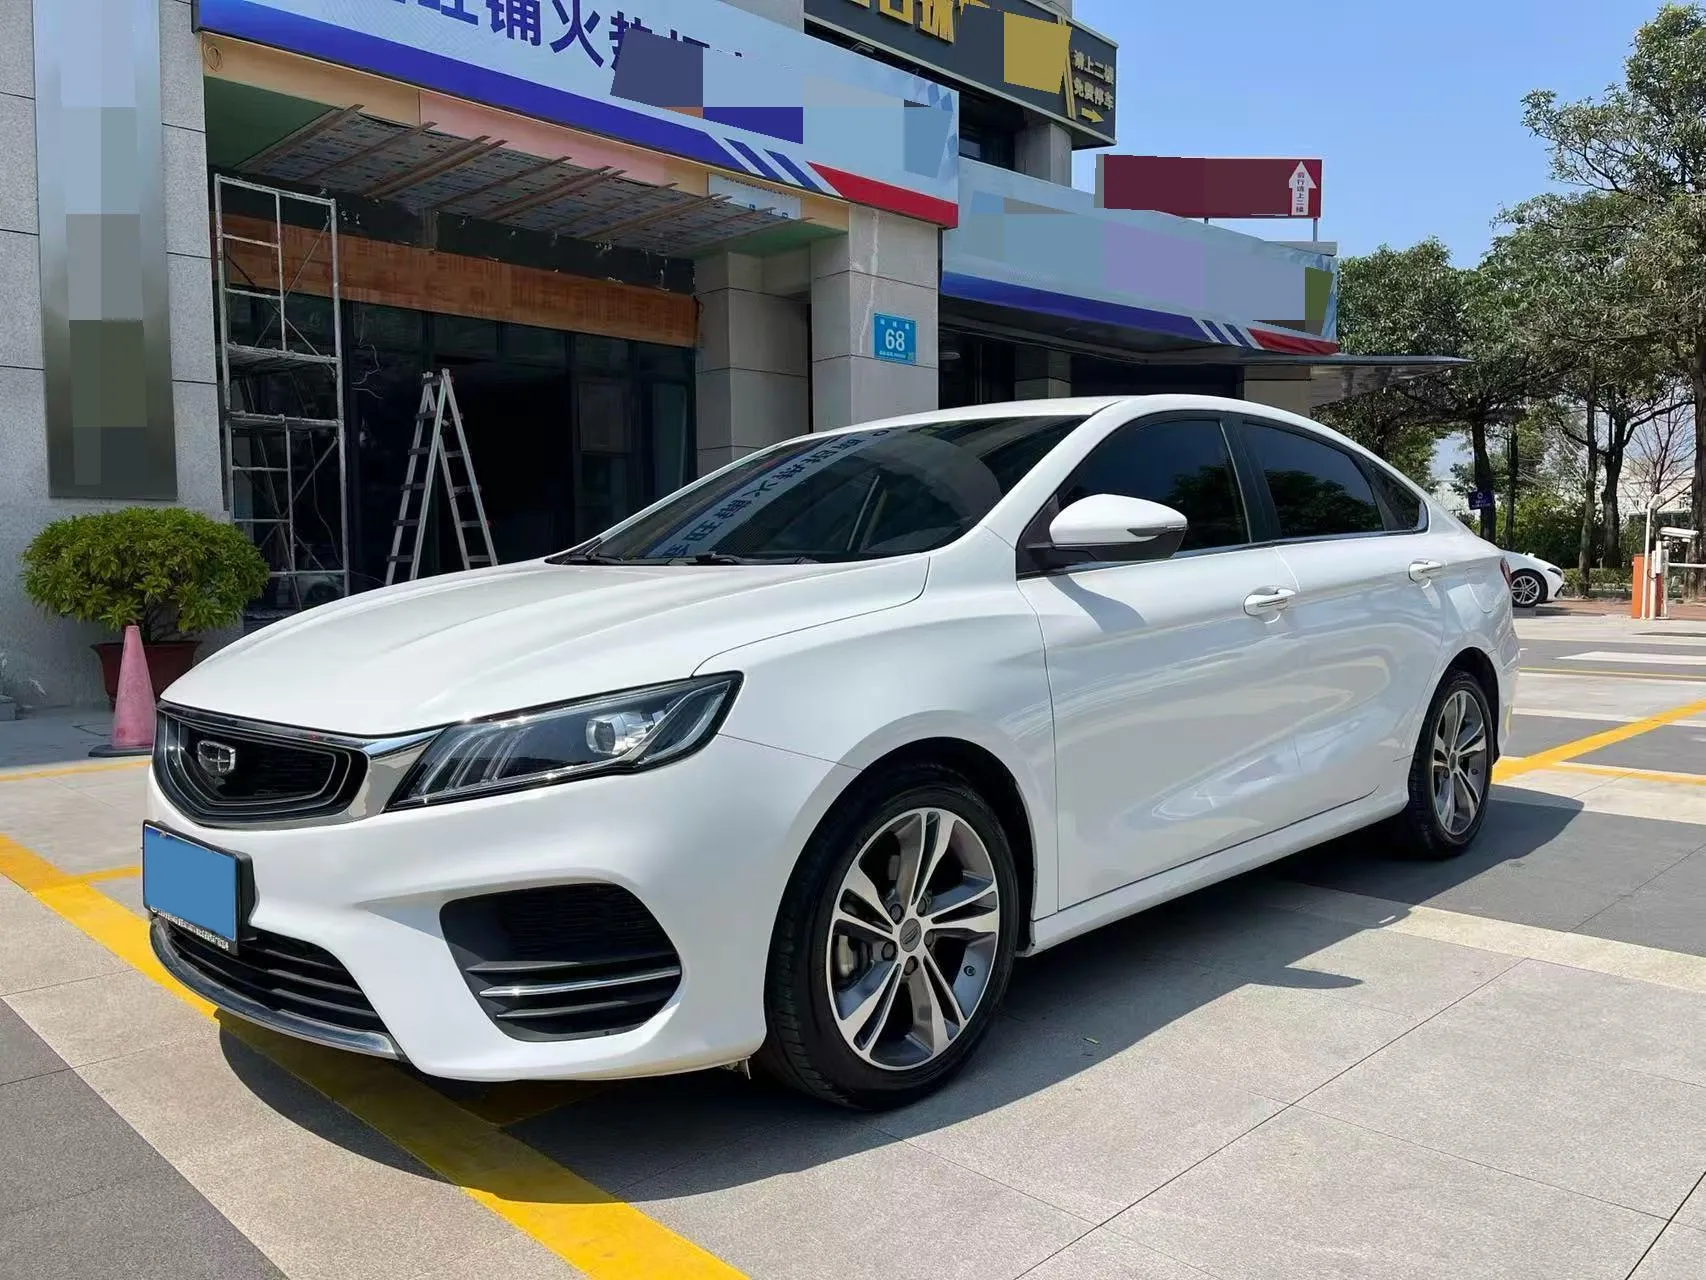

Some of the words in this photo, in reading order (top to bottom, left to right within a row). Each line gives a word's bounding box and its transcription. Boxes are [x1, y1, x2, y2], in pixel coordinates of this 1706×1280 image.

[1073, 77, 1114, 111] 免费停车
[885, 328, 905, 351] 68
